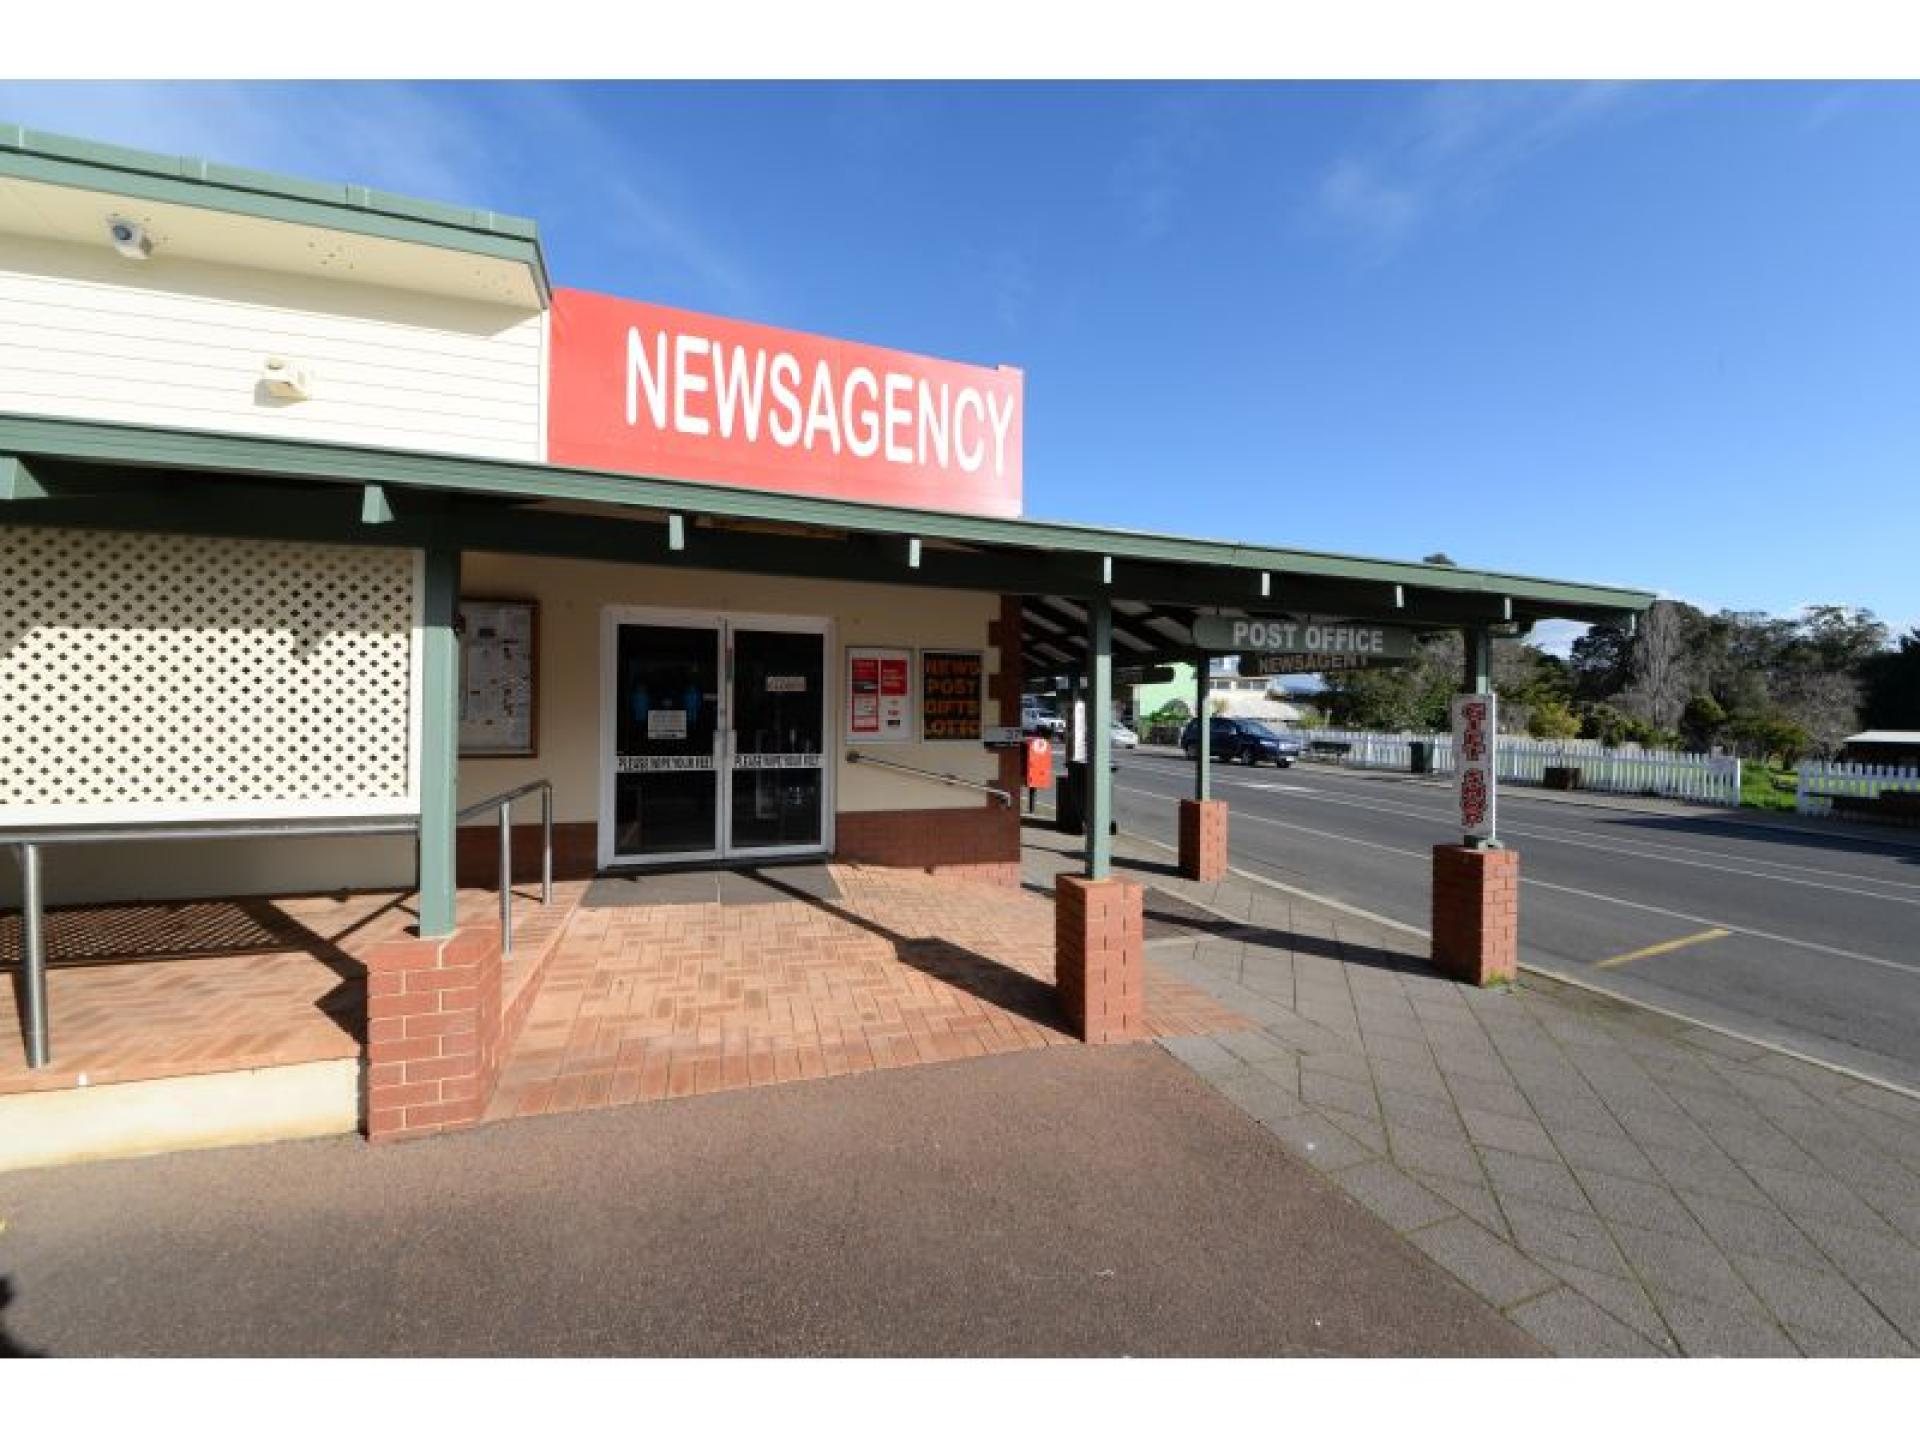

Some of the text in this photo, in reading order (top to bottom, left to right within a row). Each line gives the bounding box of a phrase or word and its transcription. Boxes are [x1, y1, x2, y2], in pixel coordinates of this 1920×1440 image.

[625, 325, 1014, 474] NEWSAGENCY
[1232, 621, 1384, 652] POST OFFICE
[926, 678, 978, 695] POST
